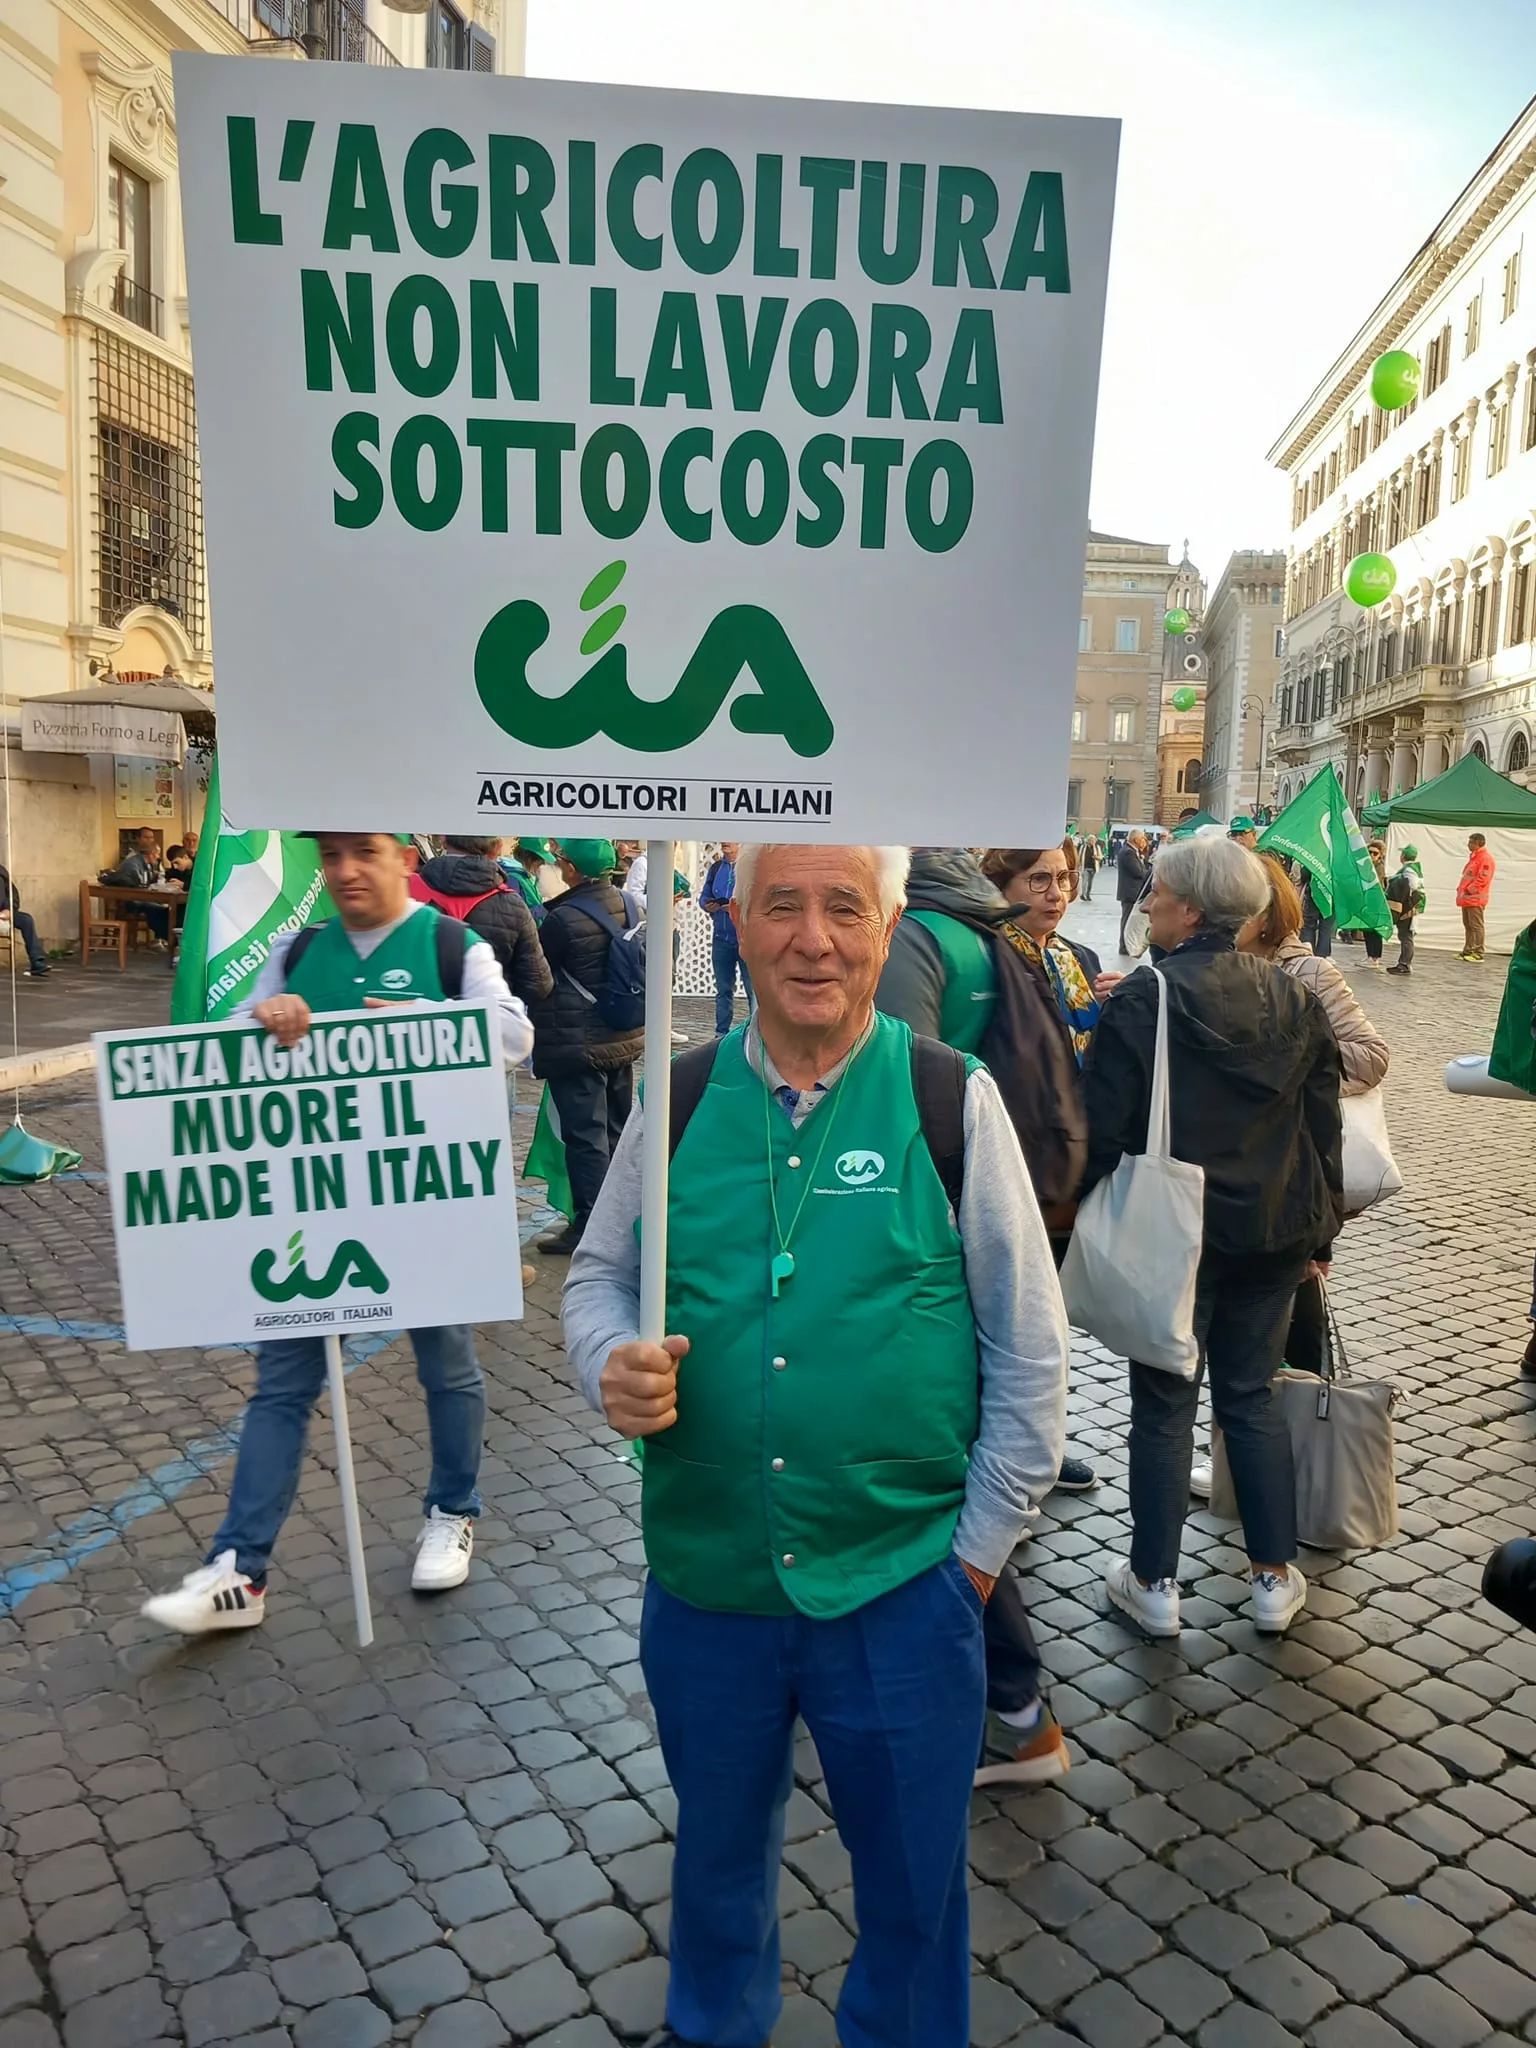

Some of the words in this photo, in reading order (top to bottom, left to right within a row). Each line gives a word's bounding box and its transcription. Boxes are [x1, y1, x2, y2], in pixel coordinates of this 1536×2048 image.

[301, 269, 541, 401] NON
[590, 287, 1004, 424] LAVORA
[331, 411, 974, 553] SOTTOCOSTO
[33, 720, 88, 737] Pizzeria
[92, 722, 133, 740] Forno
[137, 730, 144, 740] a
[477, 779, 688, 813] AGRICOLTORI
[710, 786, 833, 816] ITALIANI
[112, 1036, 229, 1095] SENZA
[240, 1016, 486, 1084] AGRICOLTURA
[173, 1085, 361, 1156] MUORE
[381, 1080, 425, 1137] IL
[125, 1160, 273, 1227] MADE
[293, 1153, 348, 1213] IN
[369, 1139, 501, 1206] ITALY
[255, 1310, 335, 1328] AGRICOLTORI
[343, 1305, 393, 1321] ITALIANI
